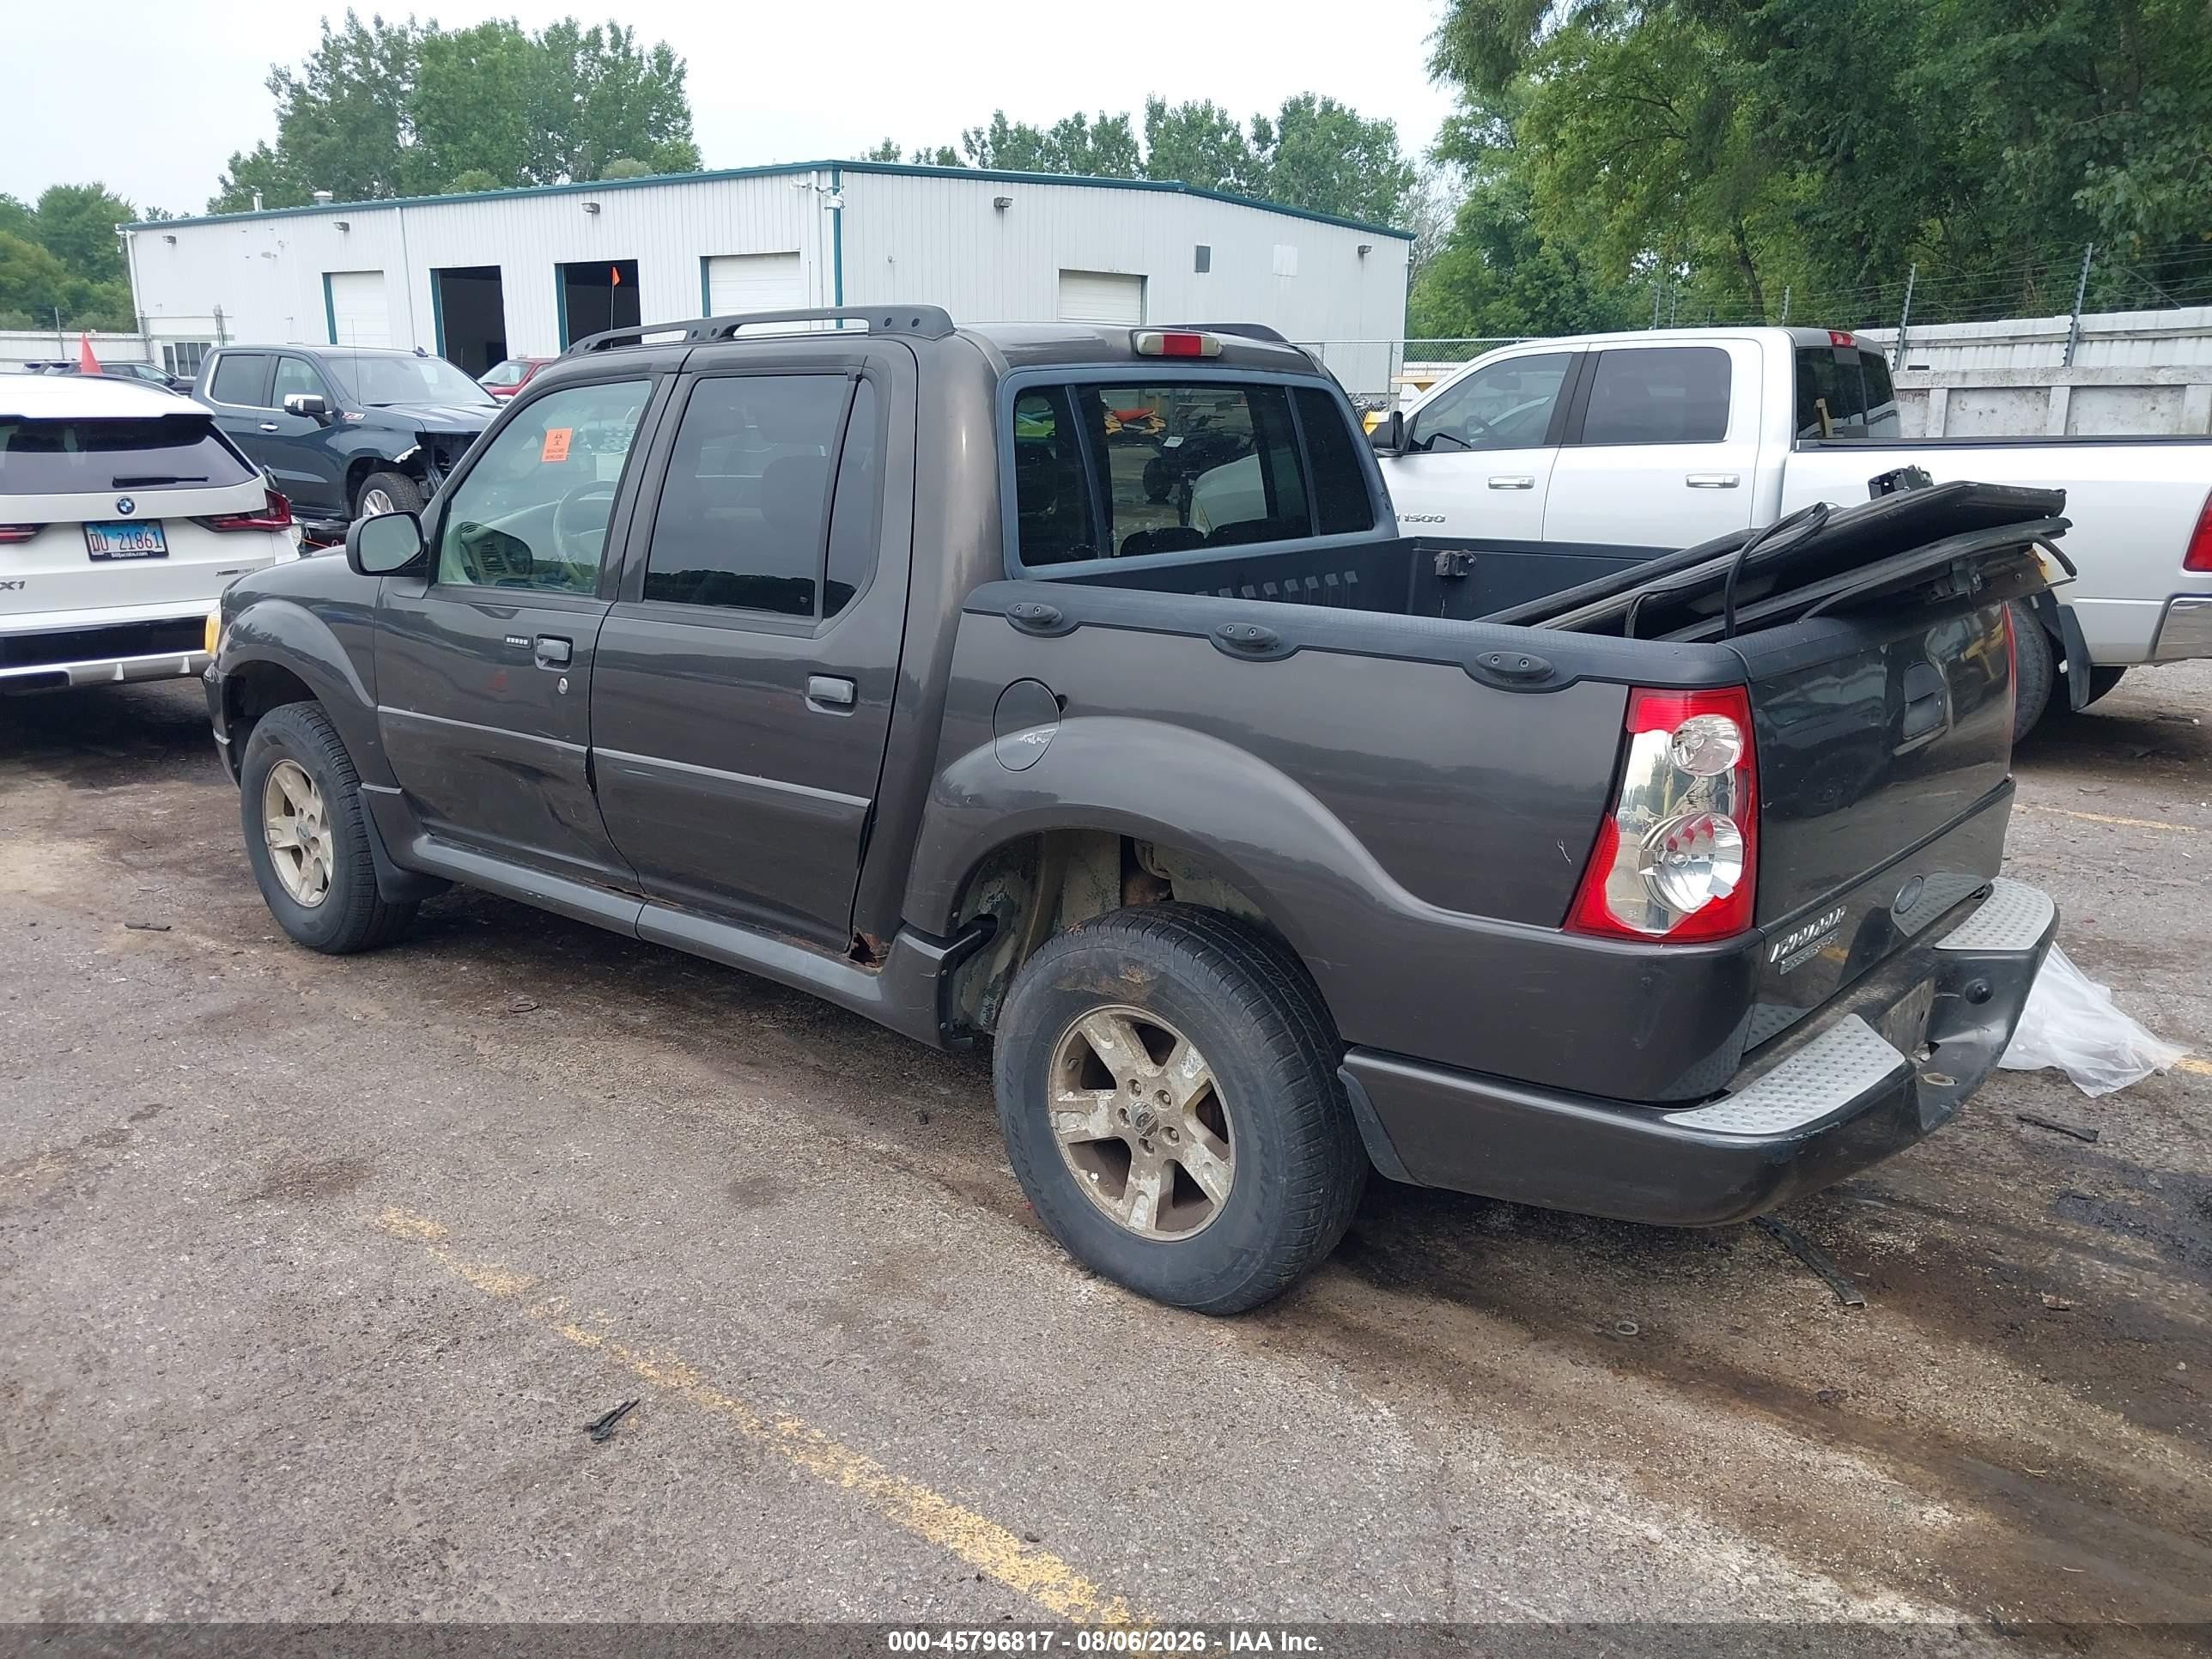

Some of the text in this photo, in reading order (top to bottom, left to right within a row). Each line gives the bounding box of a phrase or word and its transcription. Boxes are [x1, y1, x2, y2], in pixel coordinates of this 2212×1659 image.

[1404, 514, 1446, 523] 1500
[89, 531, 162, 551] DU 21861
